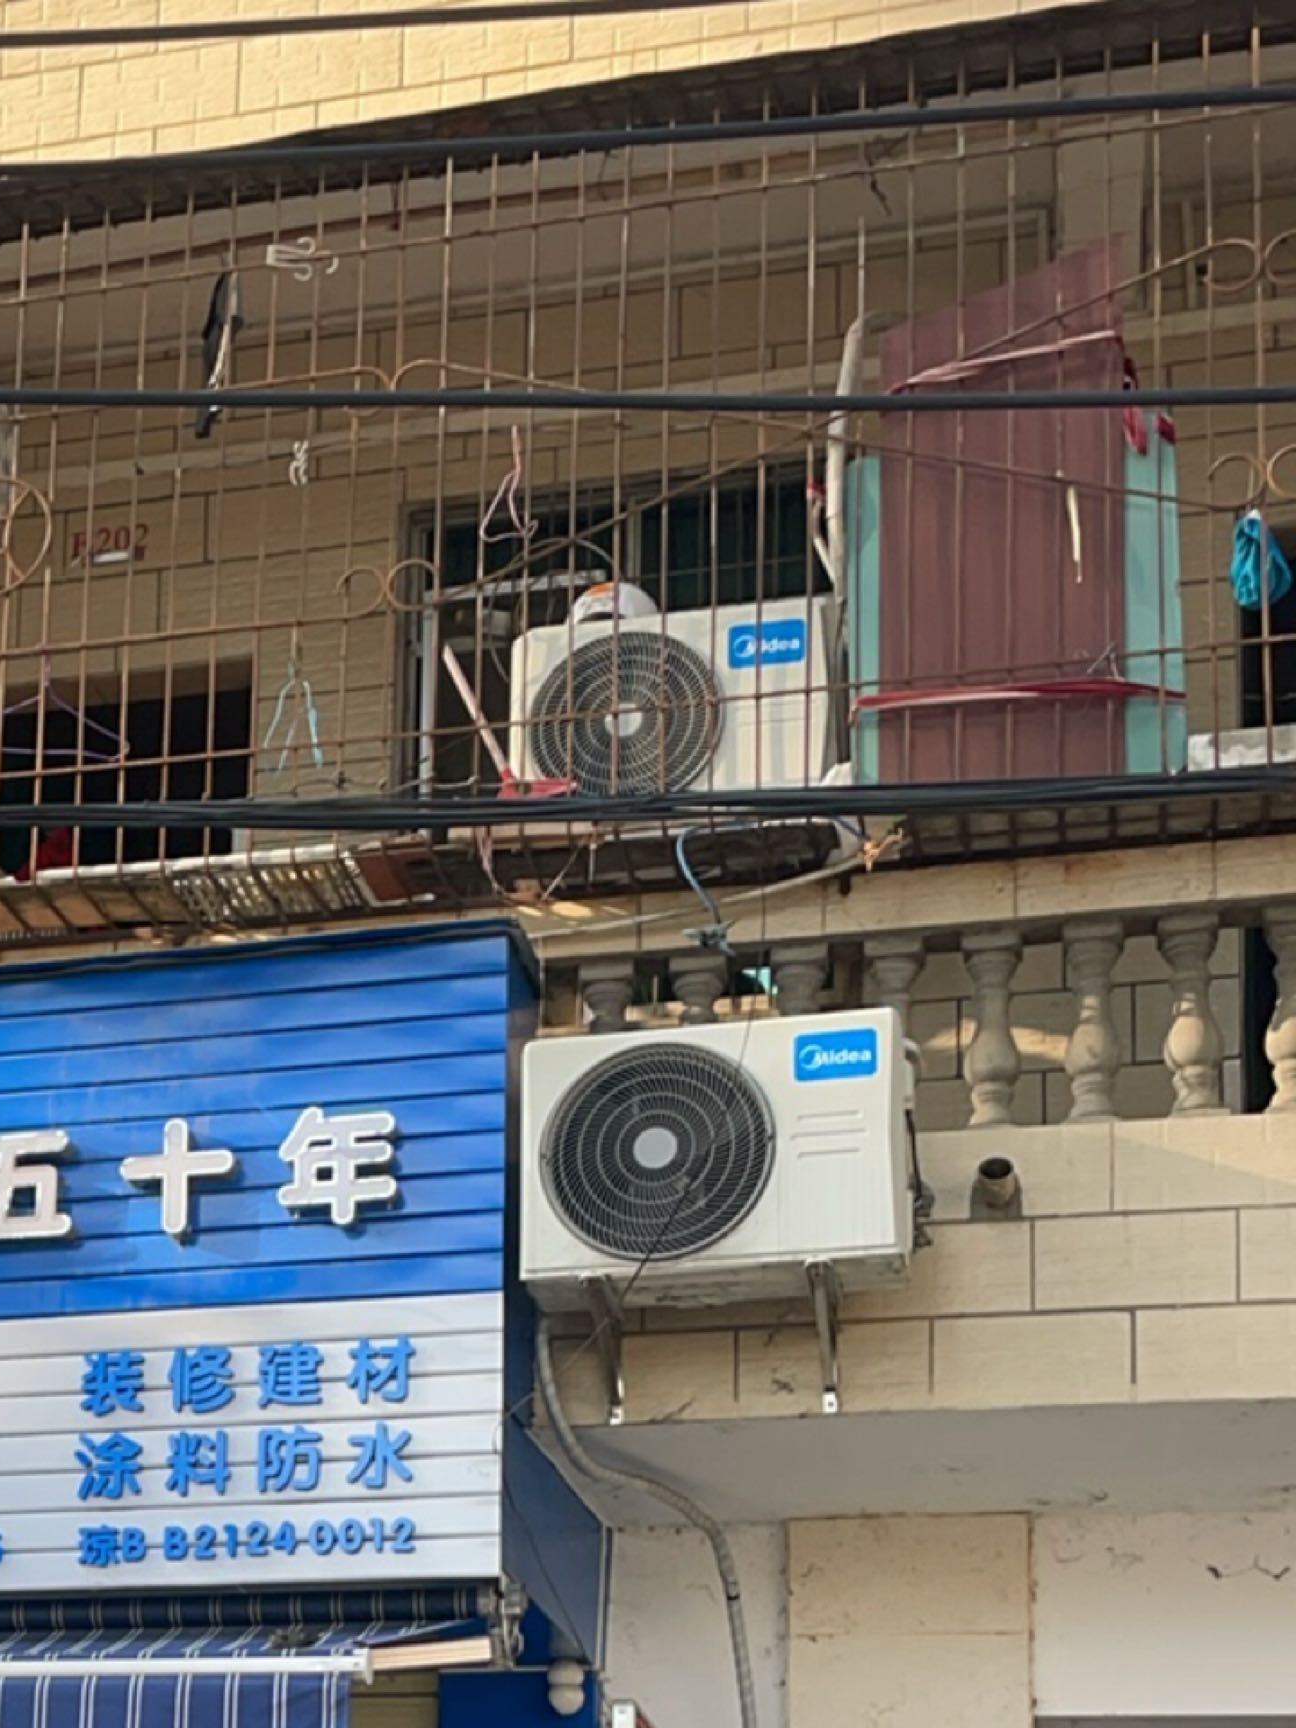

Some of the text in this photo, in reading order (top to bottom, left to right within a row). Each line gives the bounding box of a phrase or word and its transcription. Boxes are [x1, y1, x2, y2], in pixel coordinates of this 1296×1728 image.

[799, 1044, 872, 1071] Midea
[80, 1333, 415, 1417] 装修建材
[74, 1419, 415, 1500] 涂料防水
